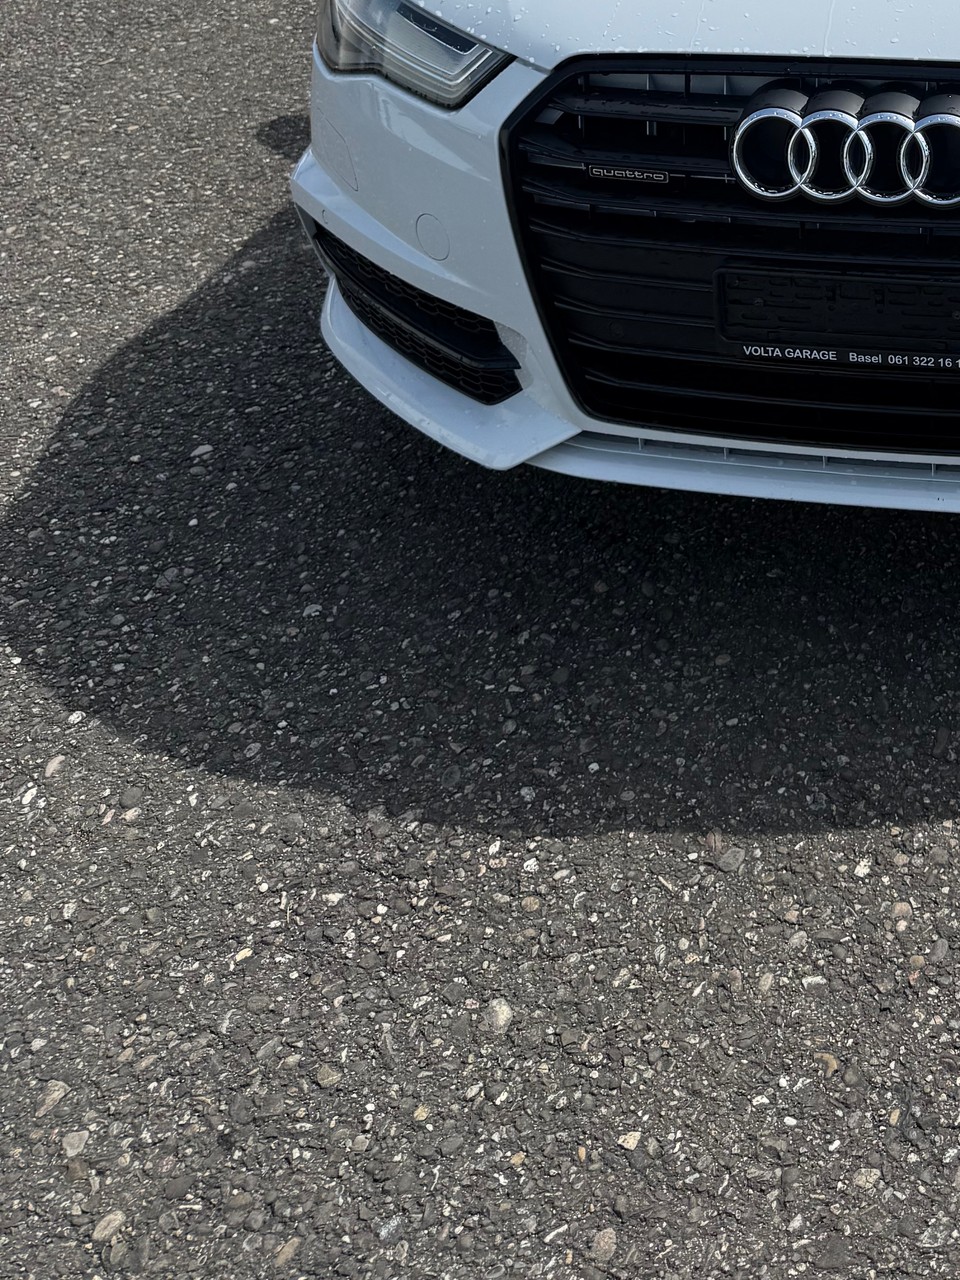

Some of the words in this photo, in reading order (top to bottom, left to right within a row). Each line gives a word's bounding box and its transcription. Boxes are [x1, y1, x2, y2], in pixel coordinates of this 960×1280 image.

[592, 168, 664, 180] quattro
[743, 345, 782, 357] VOLTA
[784, 348, 837, 361] GARAGE
[849, 352, 882, 364] Basel
[888, 354, 909, 365] 061
[912, 356, 935, 367] 322
[938, 358, 952, 368] 16
